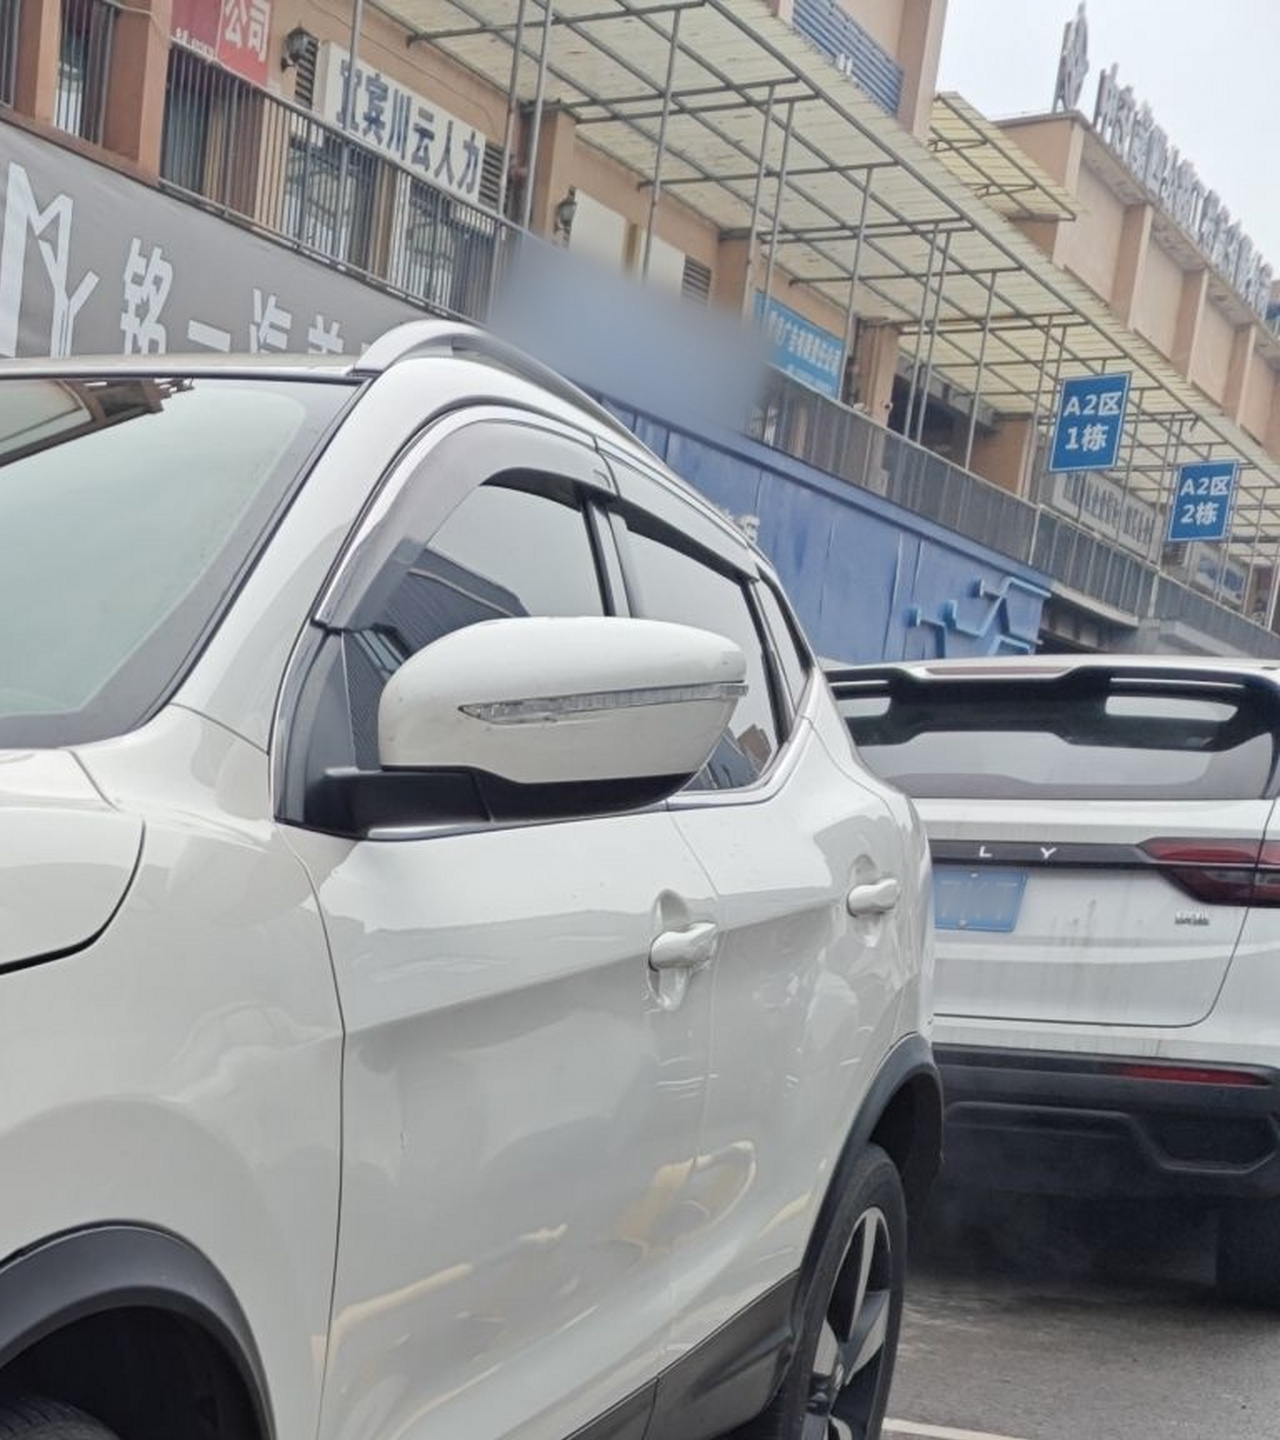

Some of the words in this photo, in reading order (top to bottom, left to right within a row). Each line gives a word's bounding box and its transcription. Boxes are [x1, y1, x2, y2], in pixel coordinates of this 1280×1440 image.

[224, 0, 268, 62] 公司
[336, 59, 481, 195] 宜宾川云人力
[1063, 391, 1123, 417] A2区
[1064, 424, 1110, 452] 1栋
[1179, 476, 1232, 496] A2区
[1180, 501, 1220, 526] 2栋
